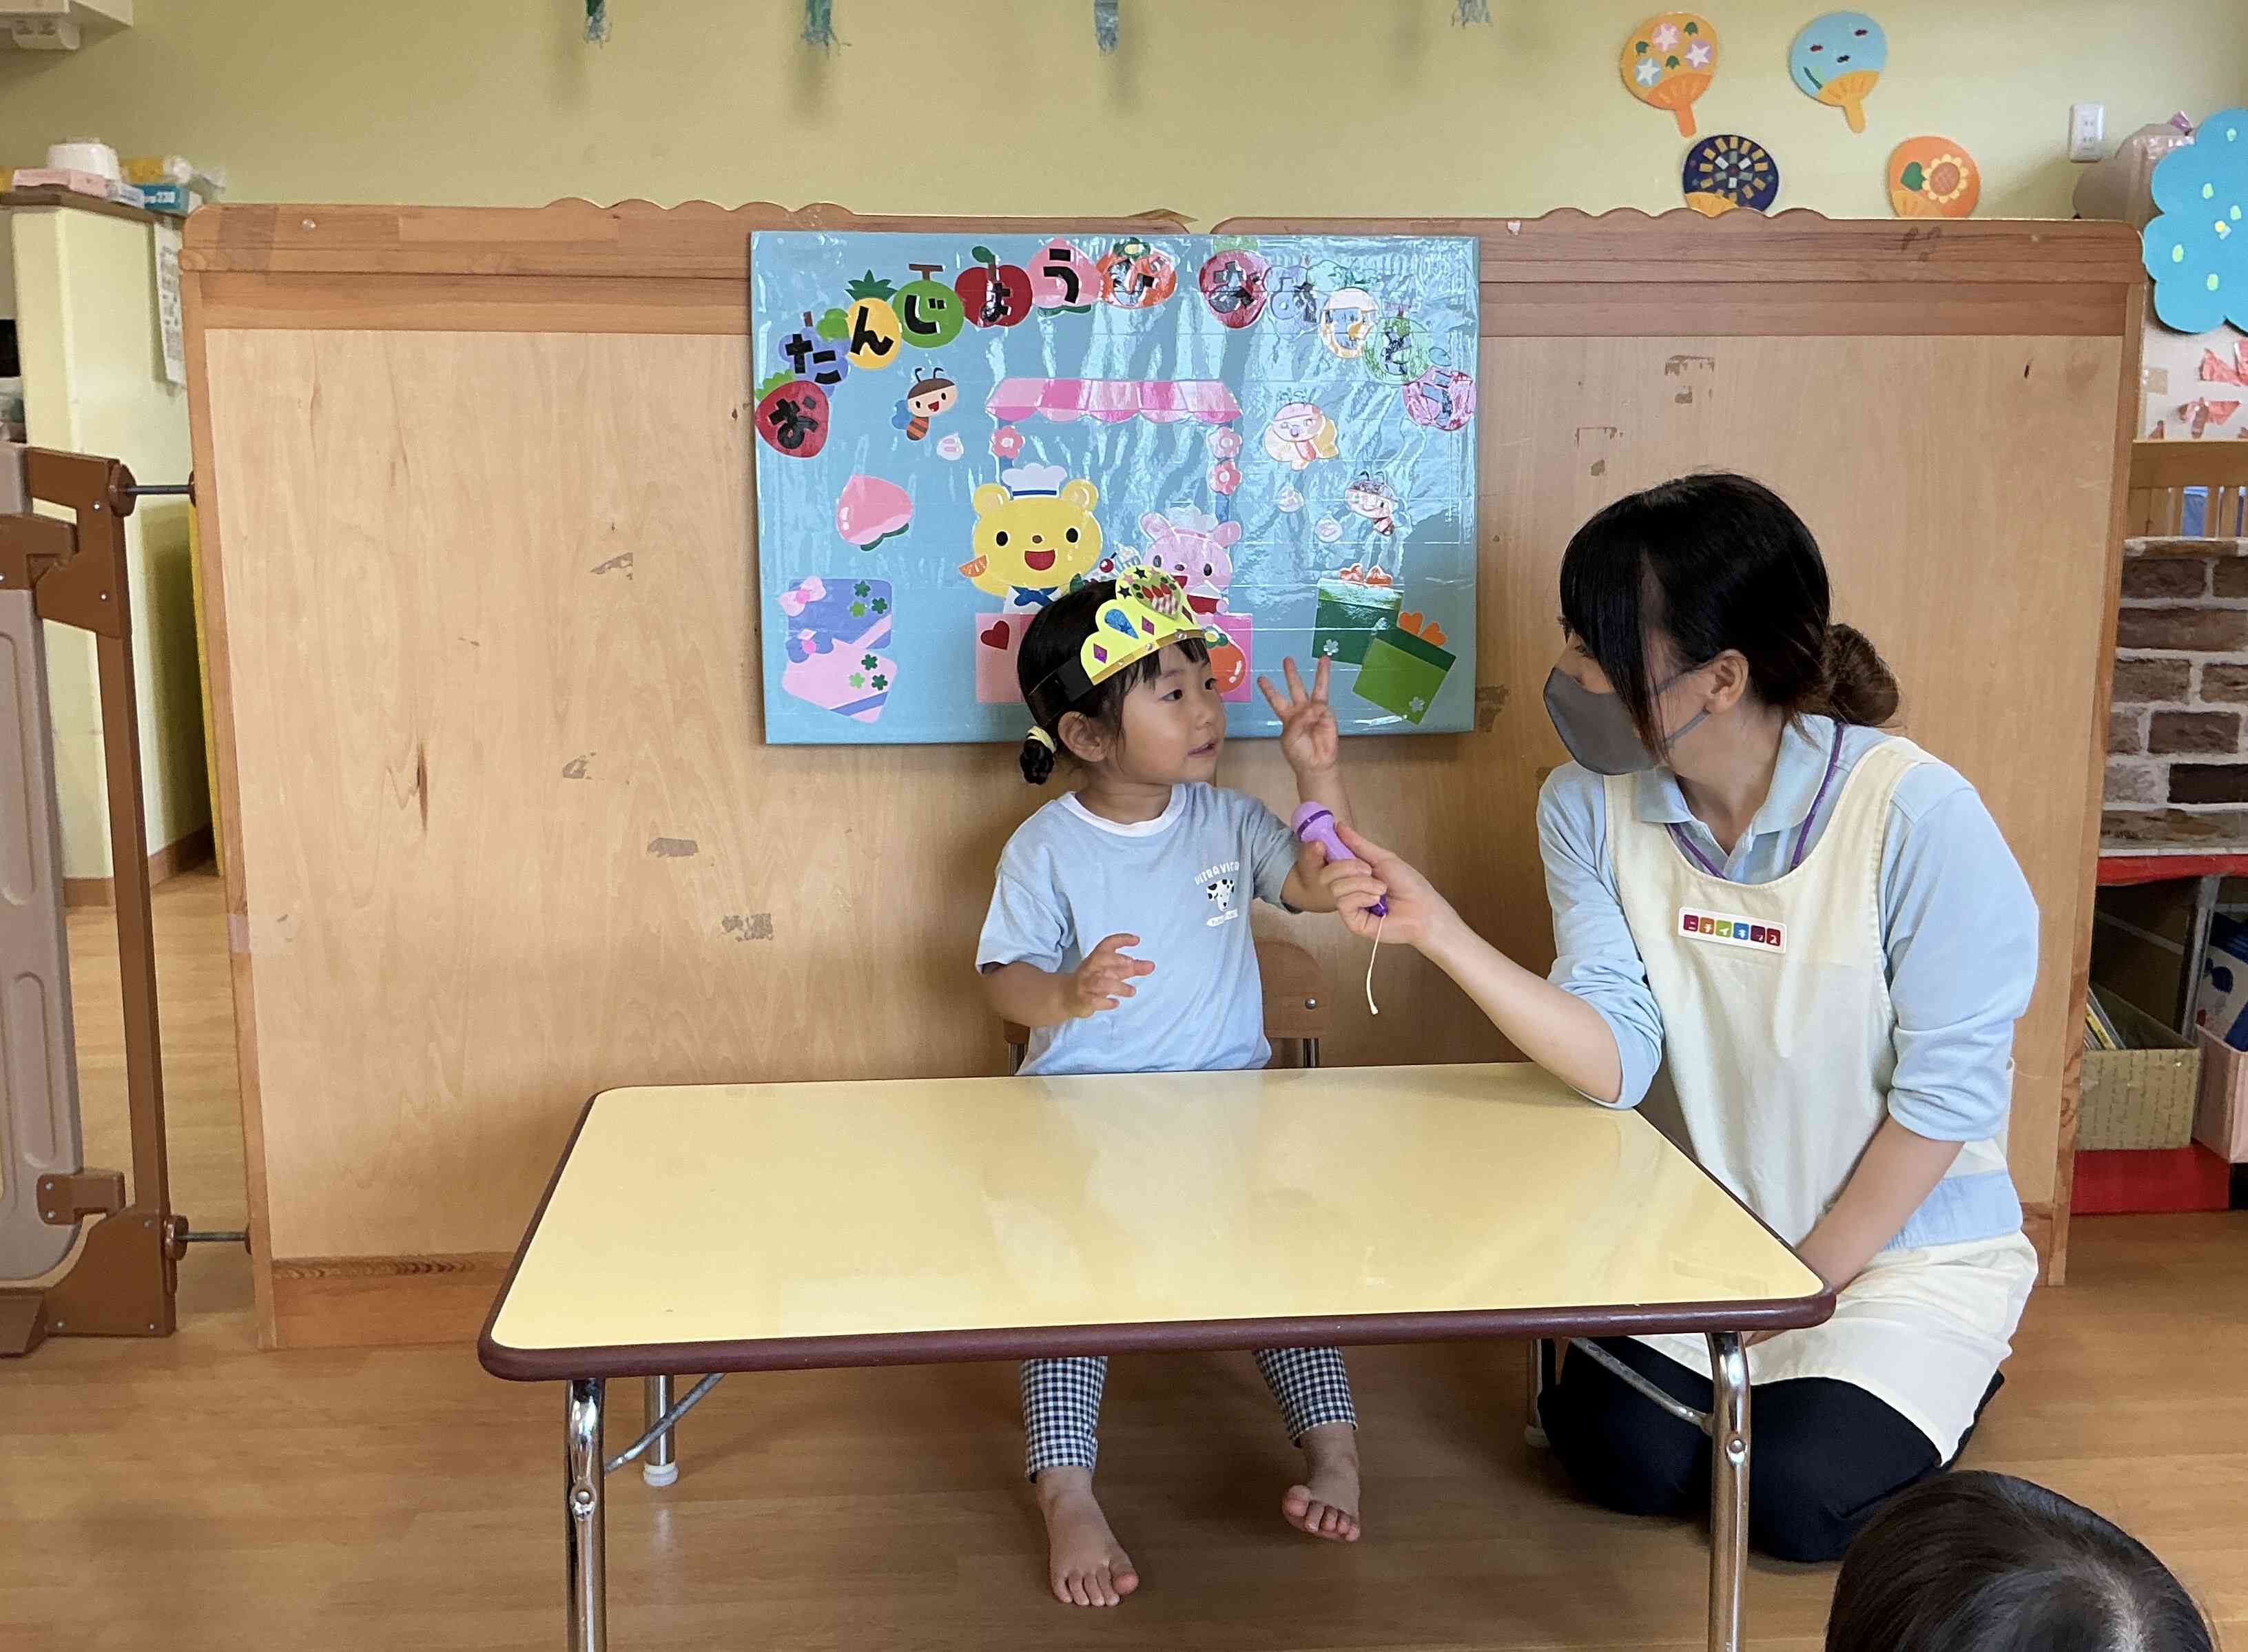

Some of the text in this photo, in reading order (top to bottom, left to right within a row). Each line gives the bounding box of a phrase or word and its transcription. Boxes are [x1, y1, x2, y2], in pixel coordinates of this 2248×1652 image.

[767, 246, 1169, 451] おたんじょうび
